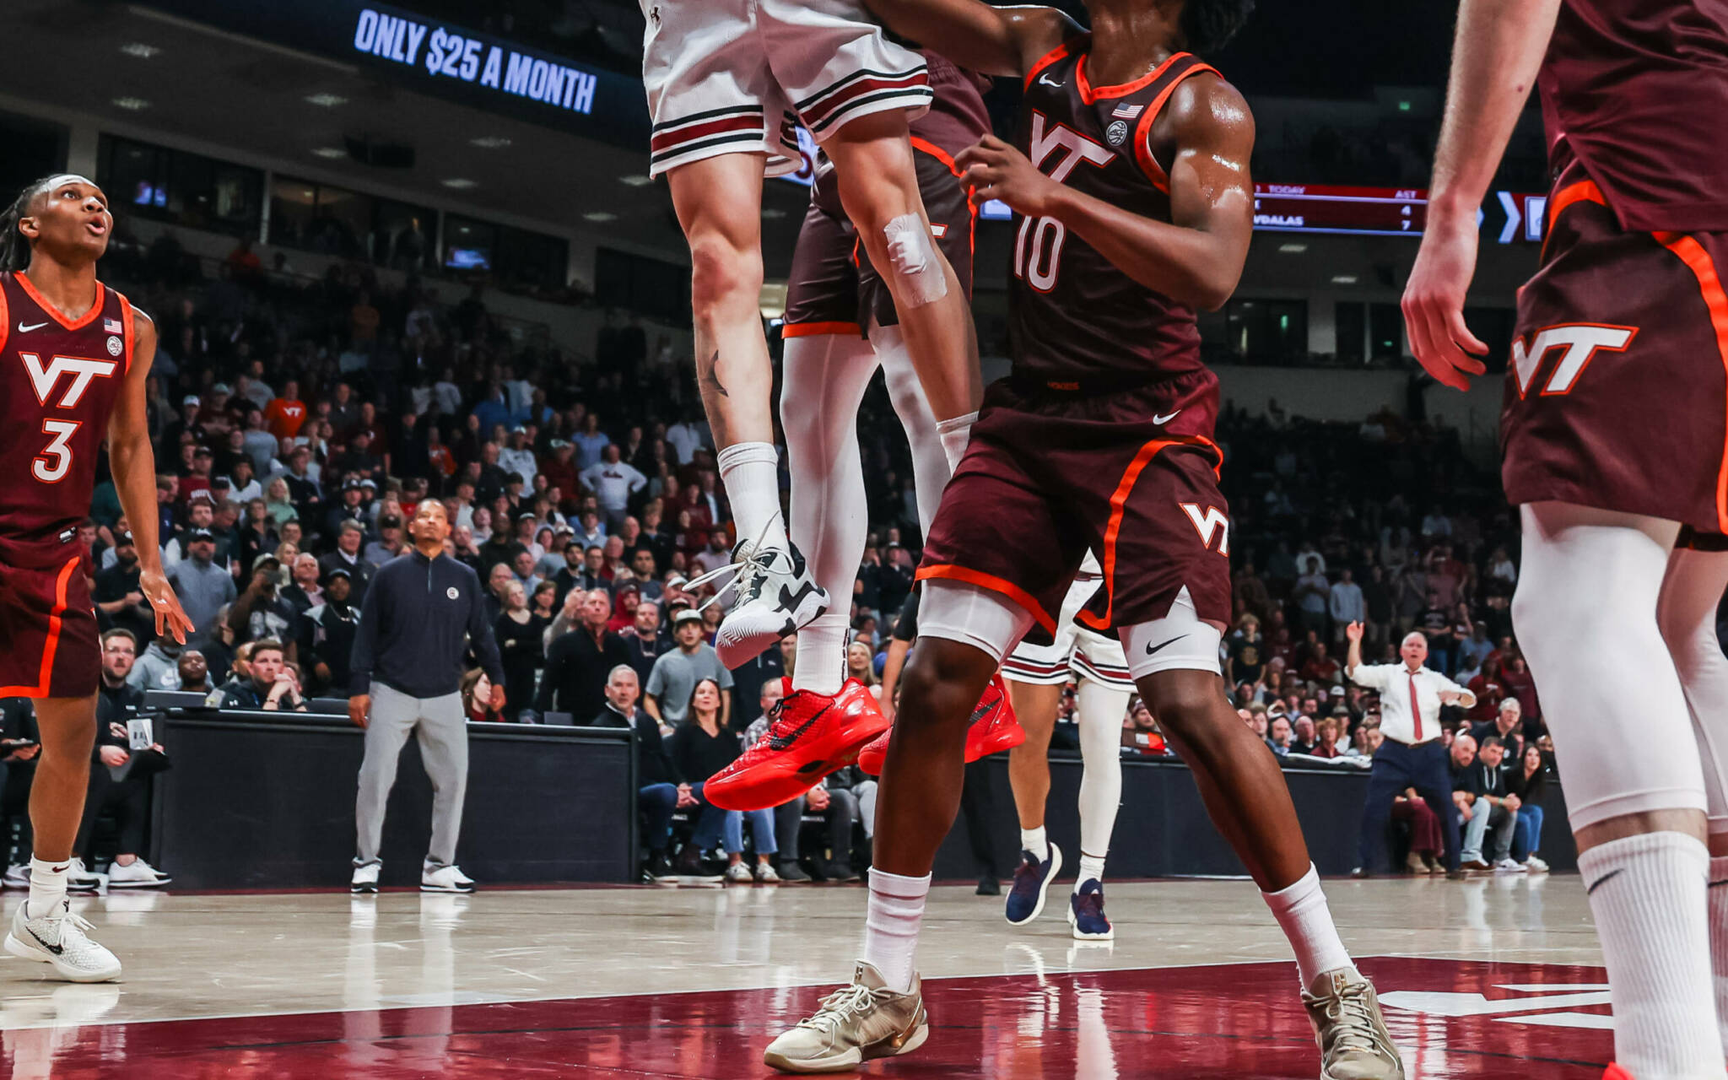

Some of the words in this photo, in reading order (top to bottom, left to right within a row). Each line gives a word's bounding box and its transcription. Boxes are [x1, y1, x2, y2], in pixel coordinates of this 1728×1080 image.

[354, 8, 428, 66] ONLY
[425, 26, 483, 82] $25
[480, 45, 504, 89] A
[503, 51, 598, 115] MONTH
[1031, 108, 1118, 183] VT
[1395, 190, 1417, 199] AST
[1401, 205, 1411, 216] 4
[1402, 220, 1411, 230] 7
[1013, 215, 1066, 294] 10
[19, 351, 118, 409] VT
[1511, 321, 1640, 401] VT
[30, 418, 83, 484] 3
